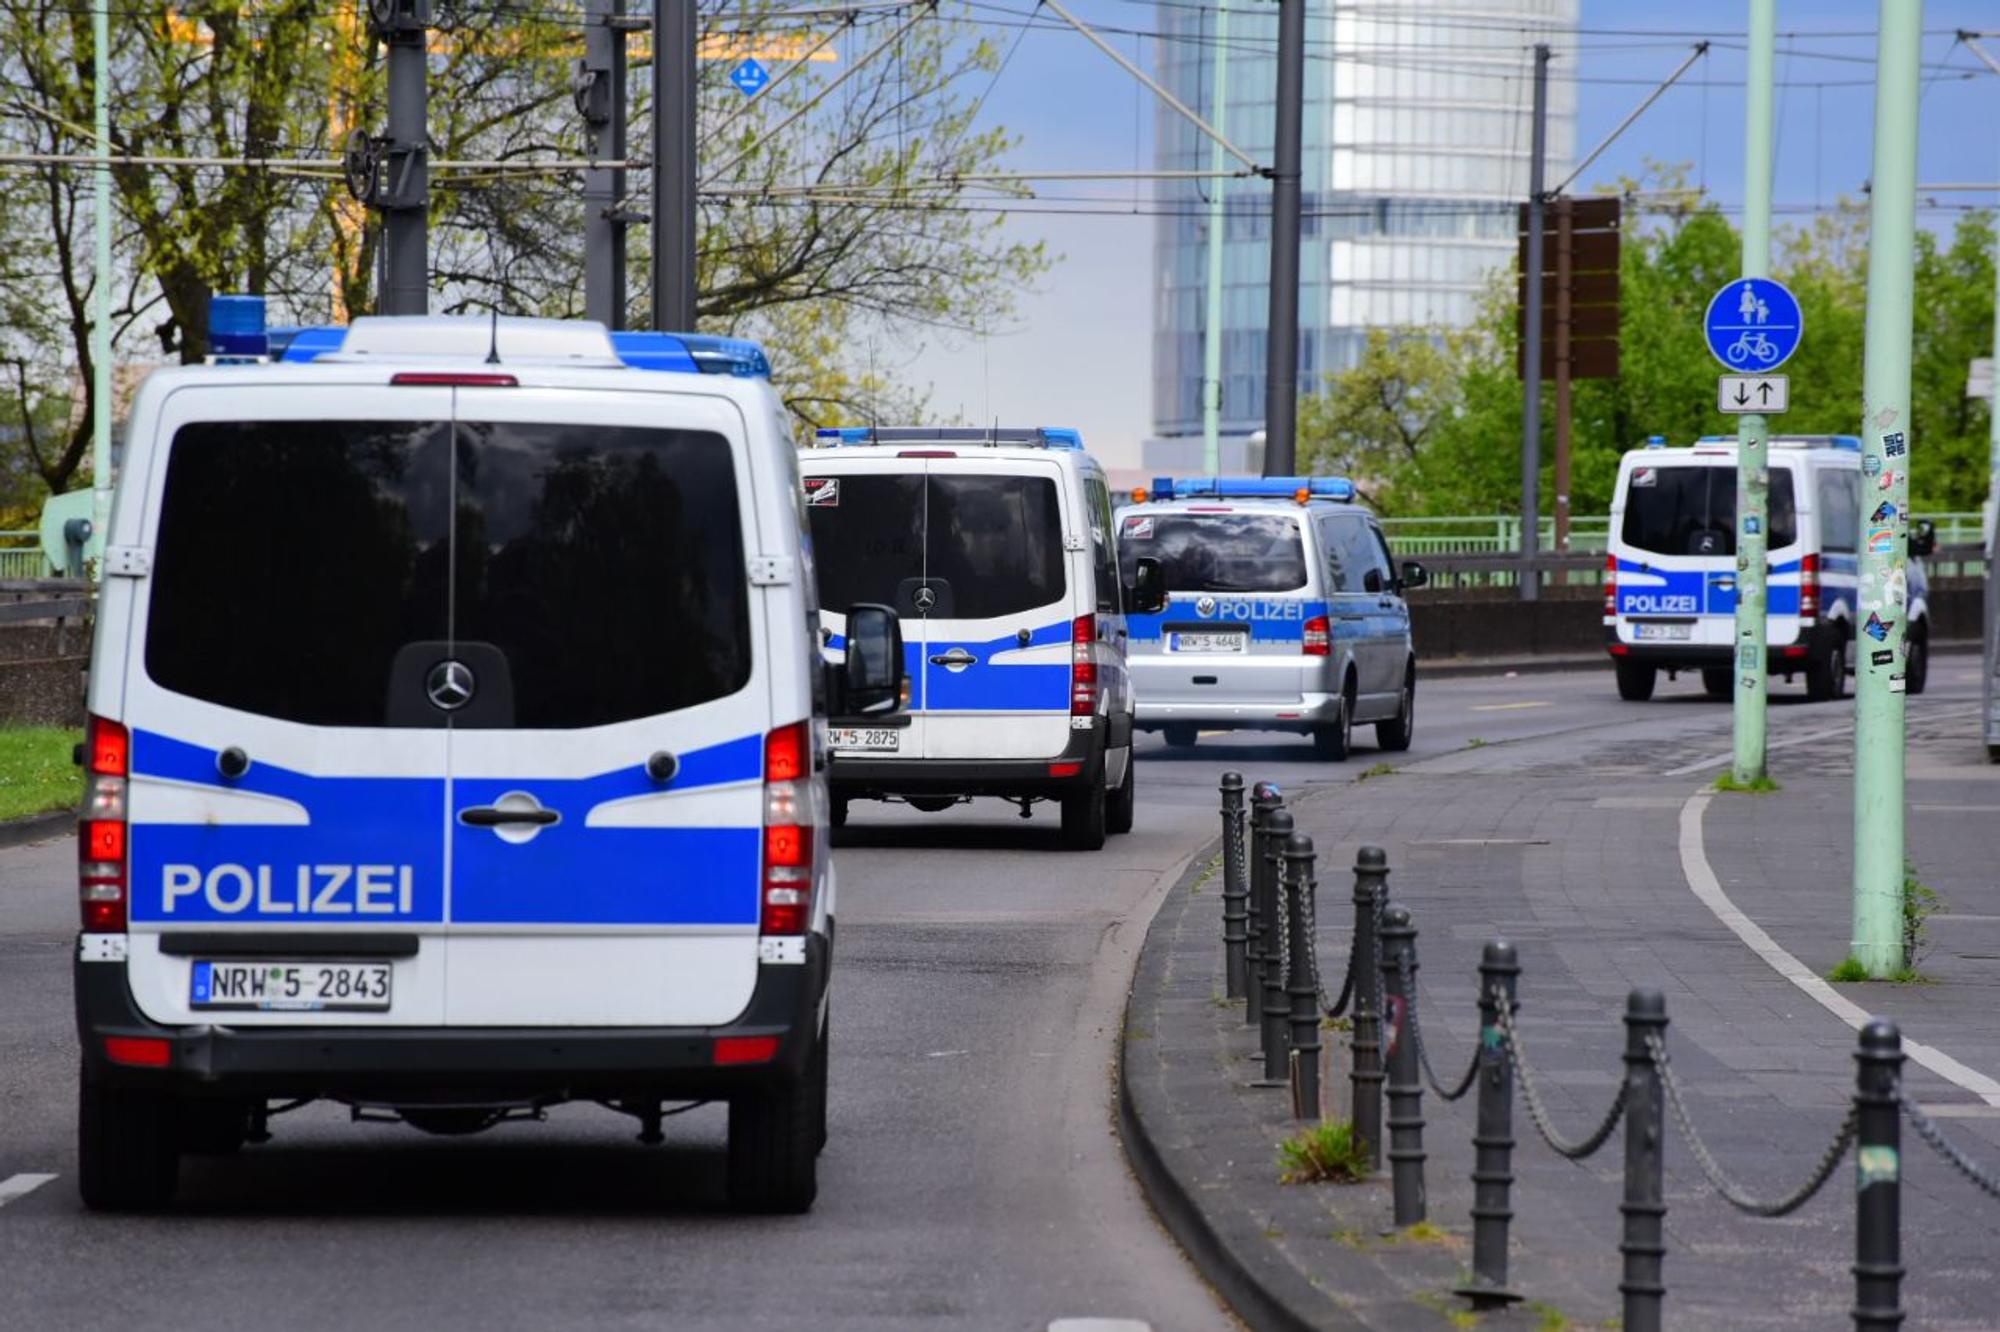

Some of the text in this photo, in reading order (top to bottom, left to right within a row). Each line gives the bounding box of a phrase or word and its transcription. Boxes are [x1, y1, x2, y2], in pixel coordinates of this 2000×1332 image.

[1219, 602, 1304, 620] POLIZEI
[1624, 595, 1696, 612] POLIZEI
[161, 863, 413, 914] POLIZEI
[212, 968, 267, 998] NRW
